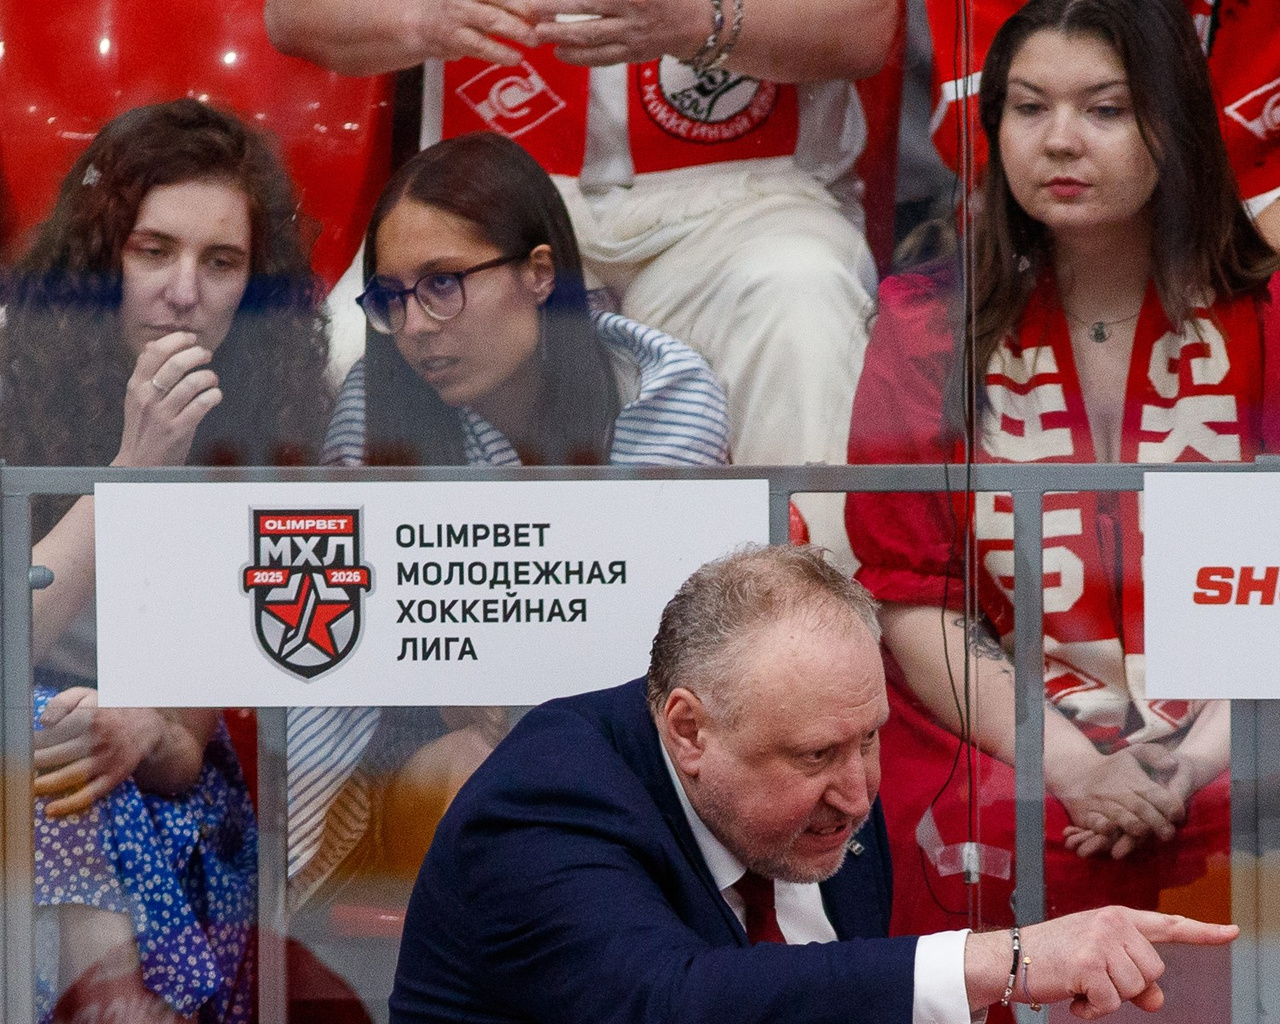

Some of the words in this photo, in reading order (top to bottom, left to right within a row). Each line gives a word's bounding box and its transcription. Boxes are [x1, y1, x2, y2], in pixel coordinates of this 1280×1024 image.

[265, 519, 348, 531] OLIMPBET
[396, 523, 550, 548] OLIMPBET
[259, 536, 354, 566] МХЛ
[253, 572, 283, 584] 2025
[331, 571, 361, 584] 2026
[397, 560, 627, 589] МОЛОДЕЖНАЯ
[396, 592, 587, 623] ХОККЕЙНАЯ
[397, 637, 478, 661] ЛИГА
